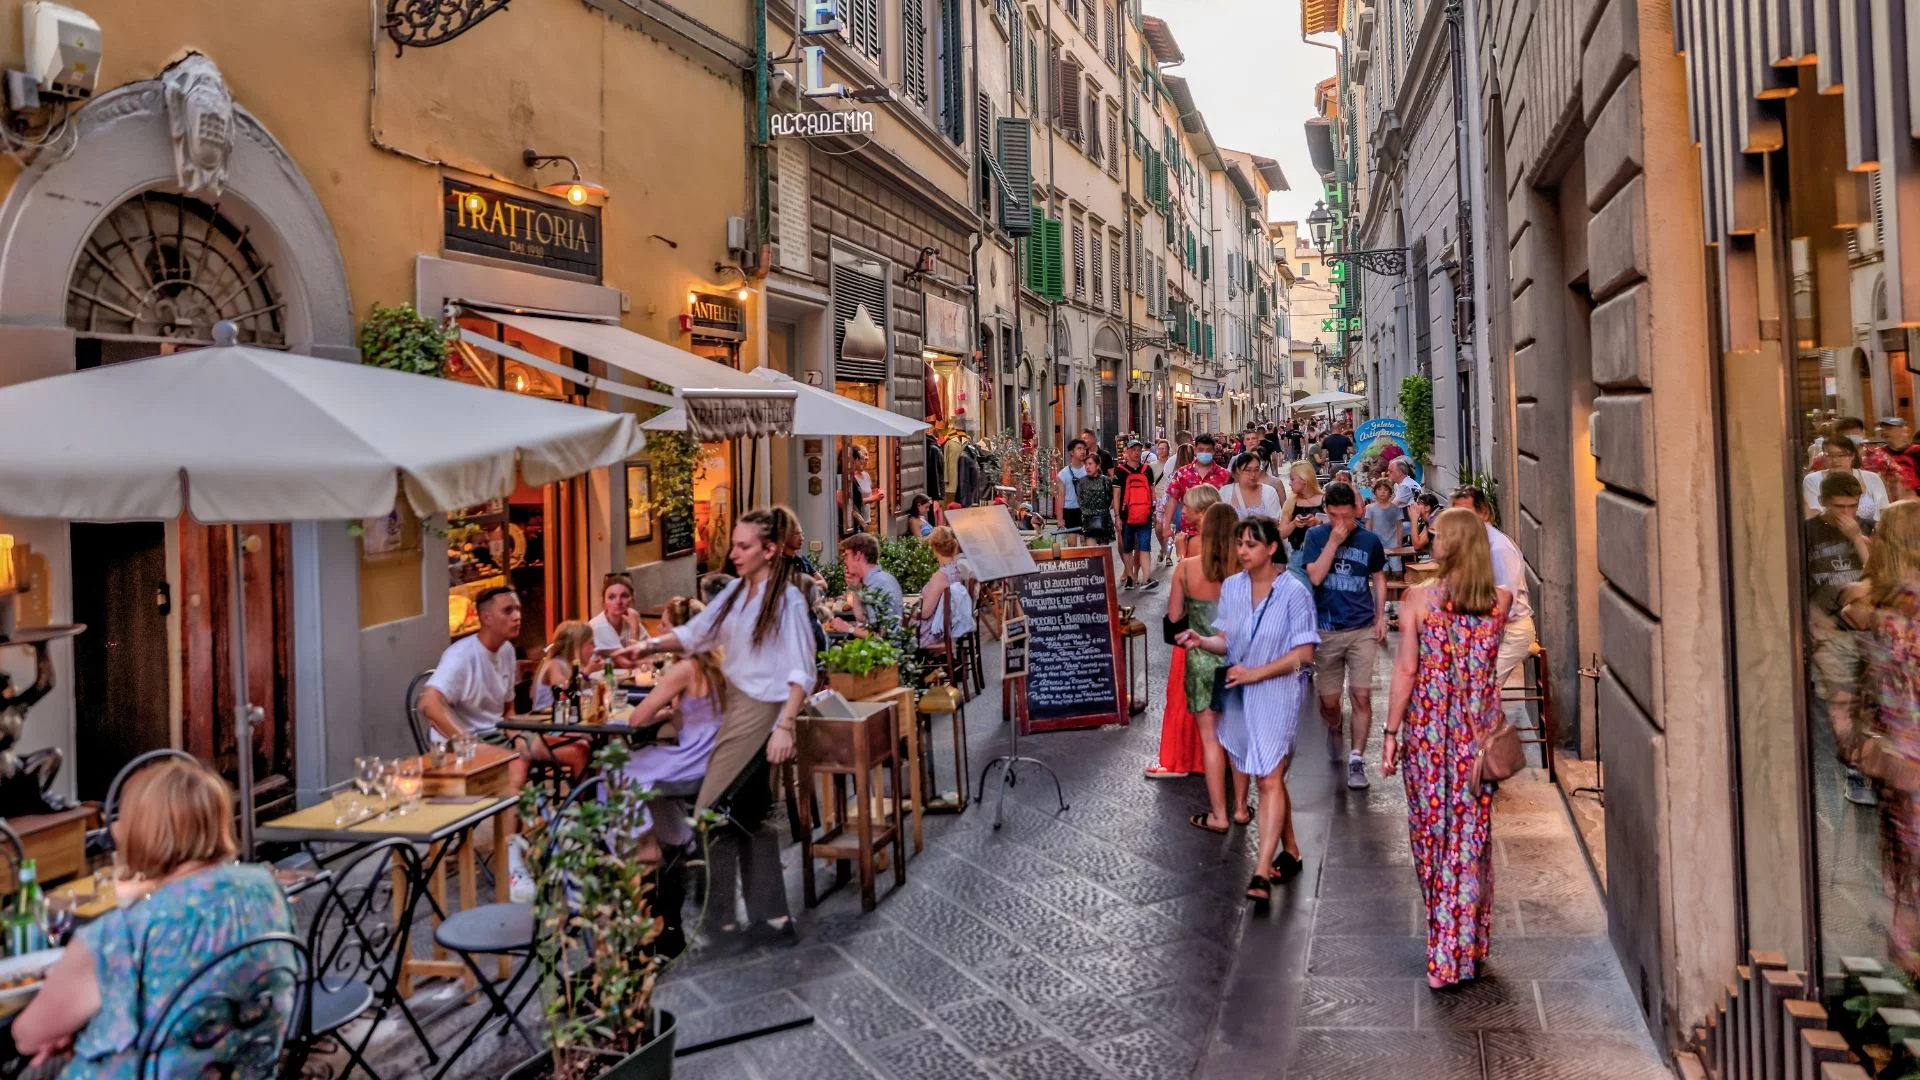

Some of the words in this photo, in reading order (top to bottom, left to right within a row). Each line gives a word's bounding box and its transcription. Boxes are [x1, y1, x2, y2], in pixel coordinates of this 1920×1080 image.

[451, 189, 590, 254] TRATTORIA
[808, 373, 815, 385] 7
[693, 407, 746, 425] TRATTORIA
[1371, 420, 1395, 430] Gelato
[1028, 616, 1057, 626] OMODORO
[1057, 616, 1063, 625] E
